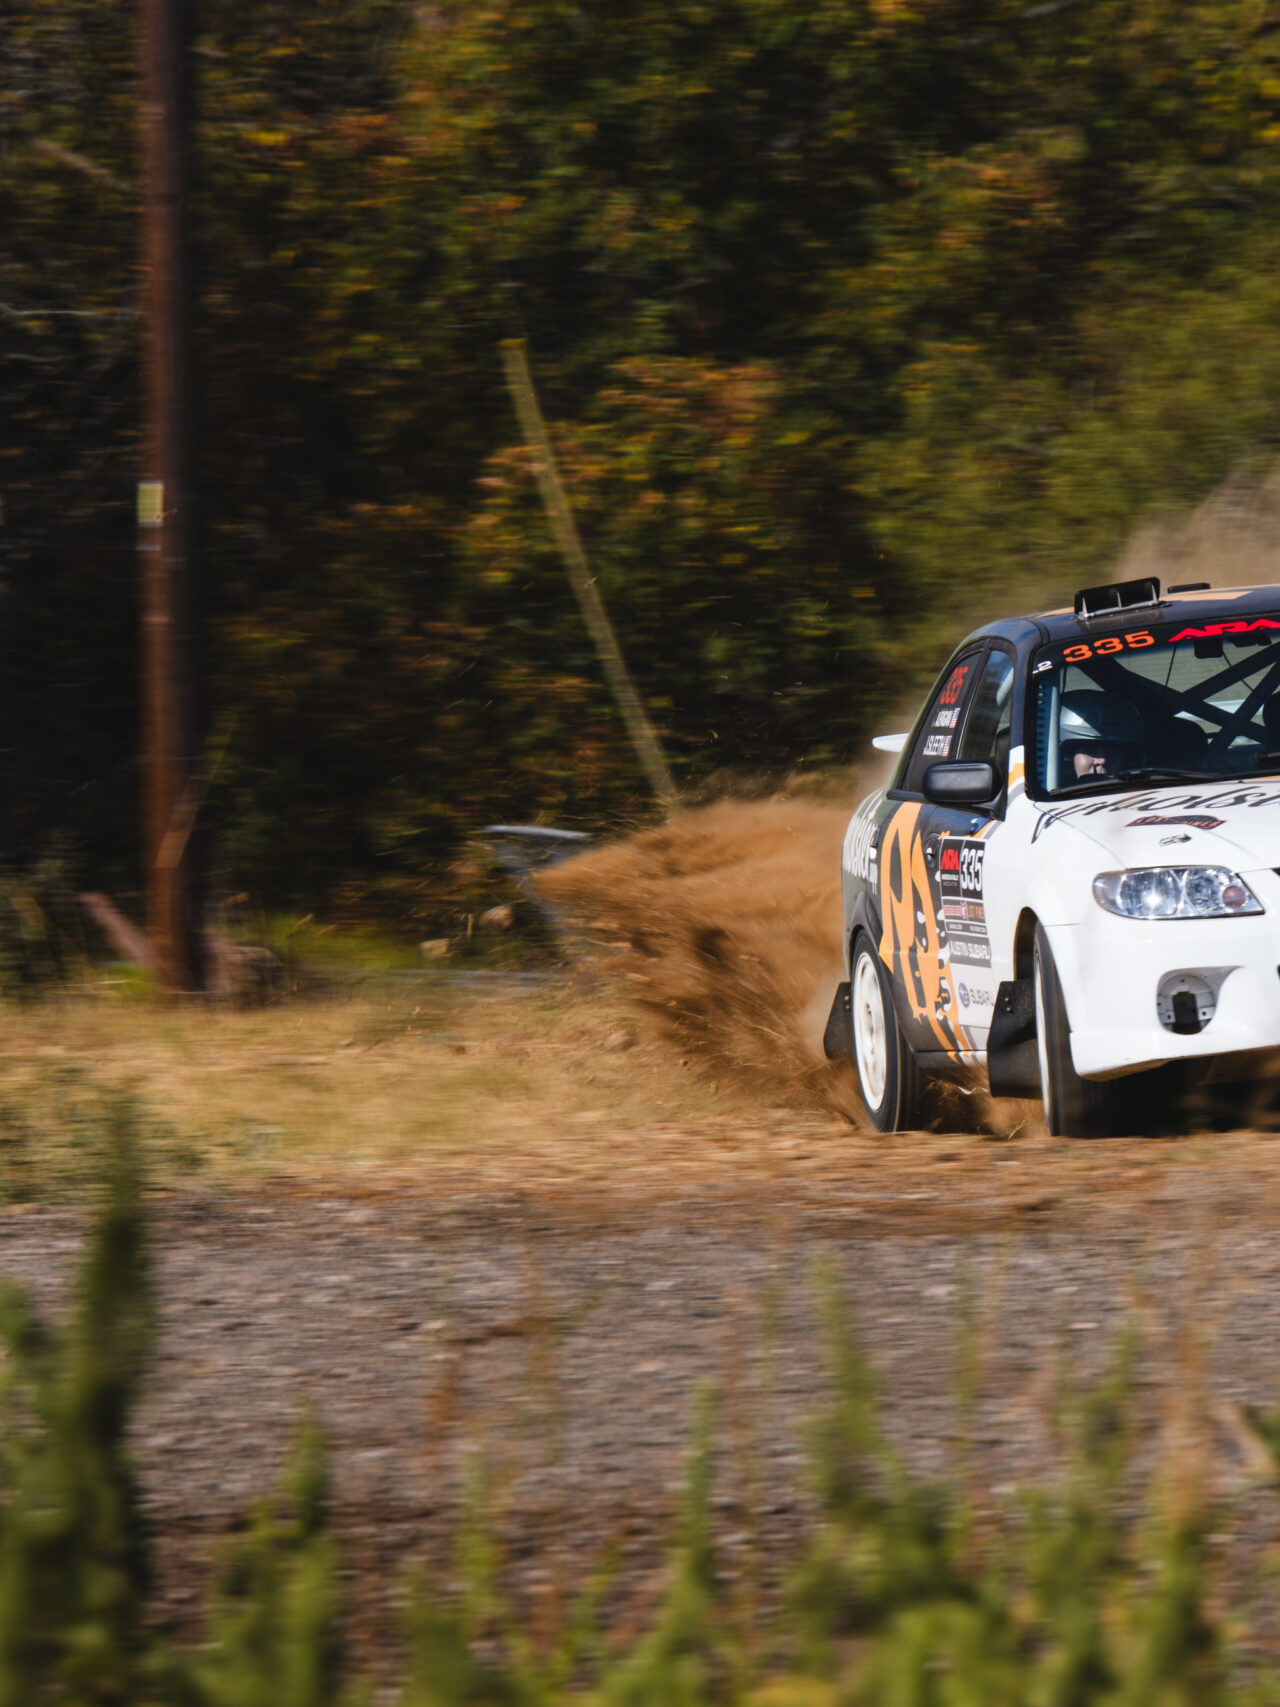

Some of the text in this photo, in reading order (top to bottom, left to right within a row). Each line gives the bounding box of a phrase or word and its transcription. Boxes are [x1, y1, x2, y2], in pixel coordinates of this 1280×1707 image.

[1062, 630, 1155, 662] 335
[940, 849, 960, 870] ARA
[961, 848, 984, 891] 335
